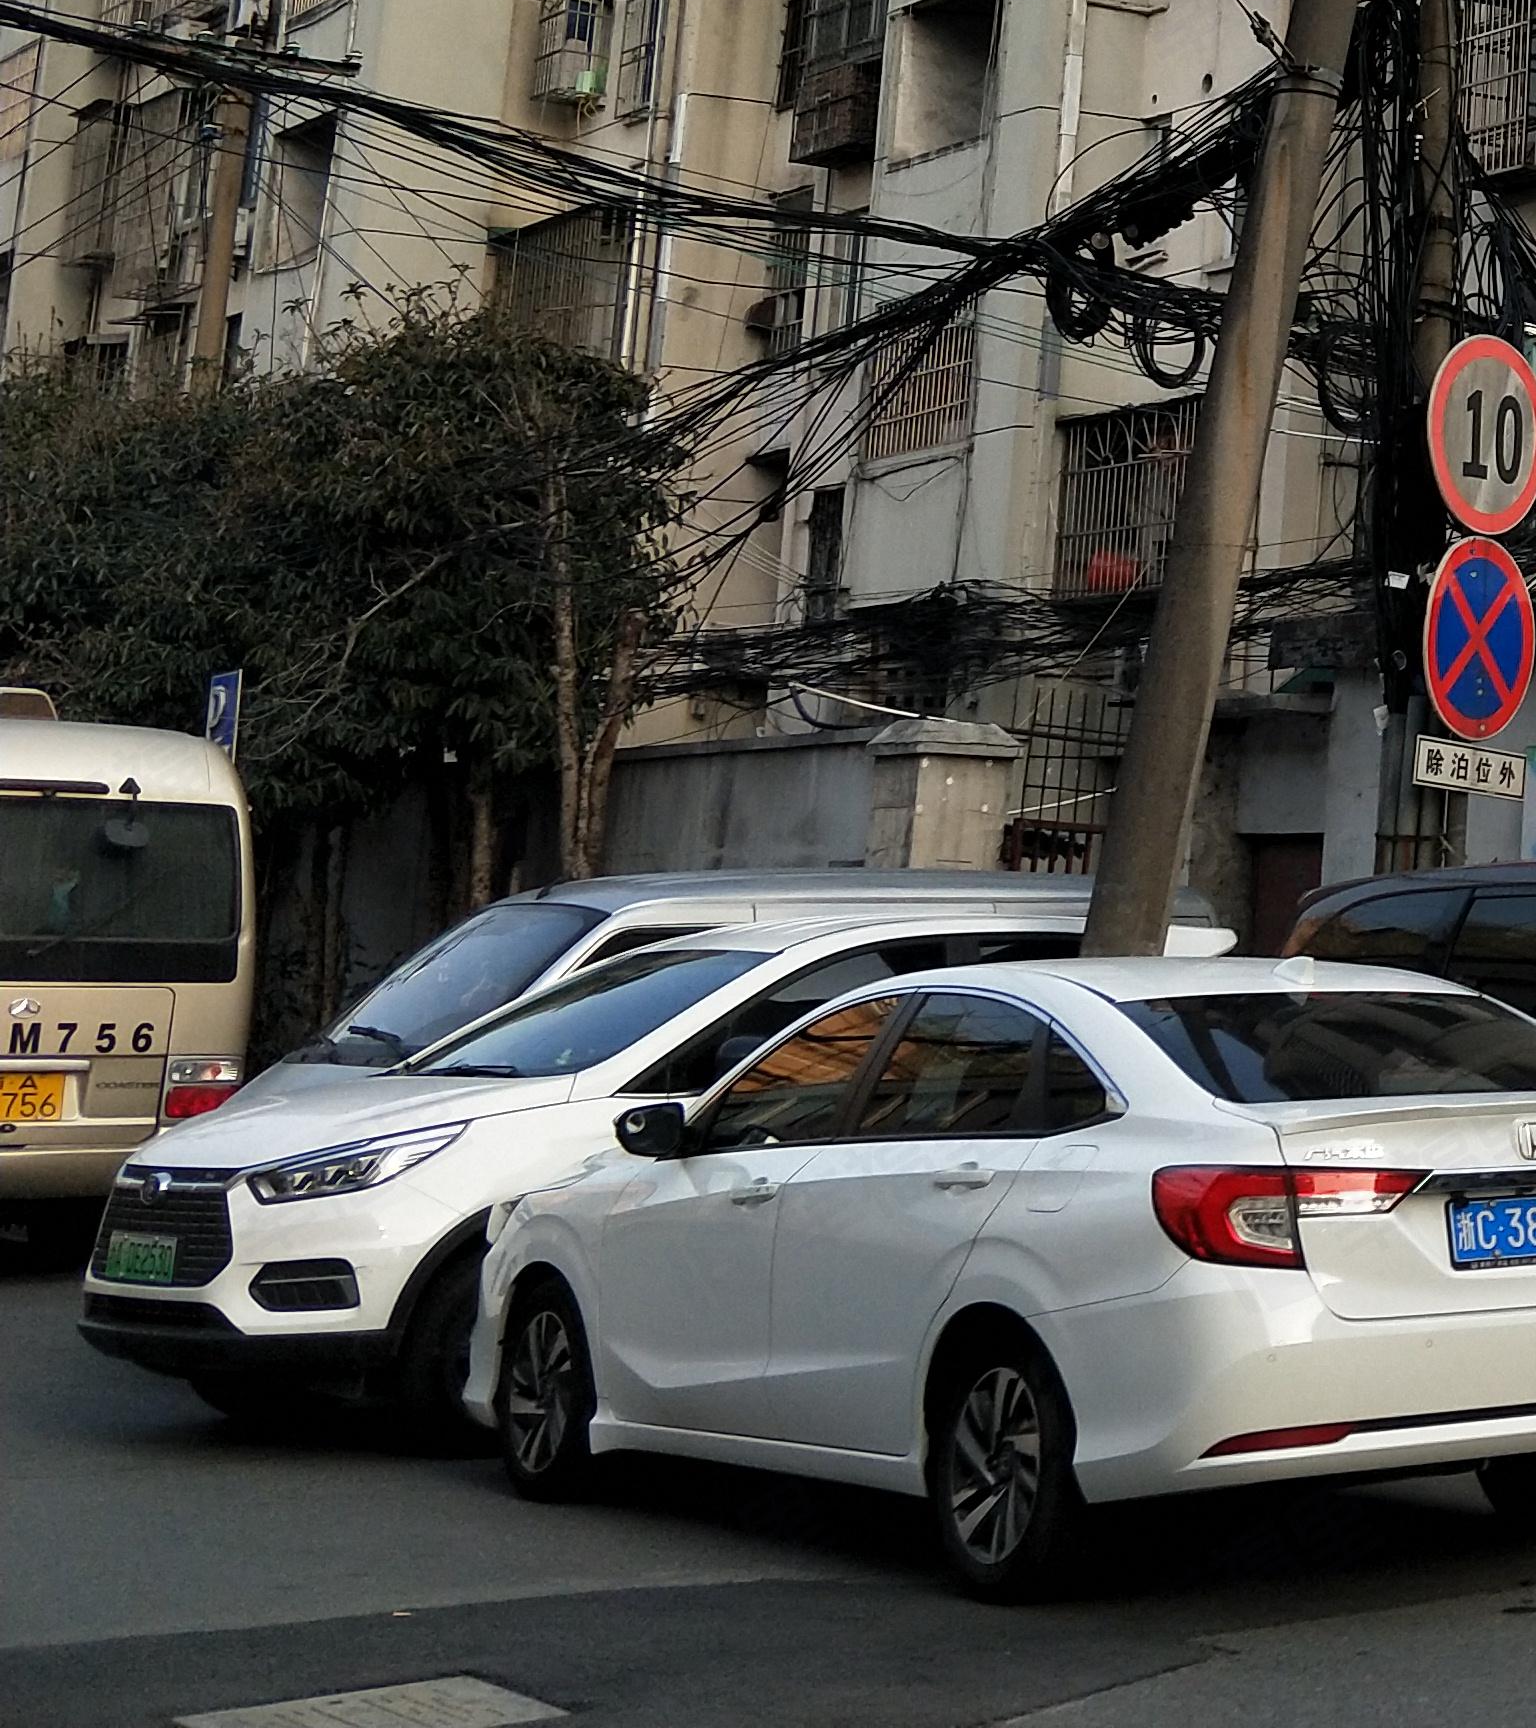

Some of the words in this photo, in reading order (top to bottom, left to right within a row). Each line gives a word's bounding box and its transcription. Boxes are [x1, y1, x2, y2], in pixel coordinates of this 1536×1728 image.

[1462, 389, 1522, 484] 10
[1425, 747, 1518, 790] 除泊位外
